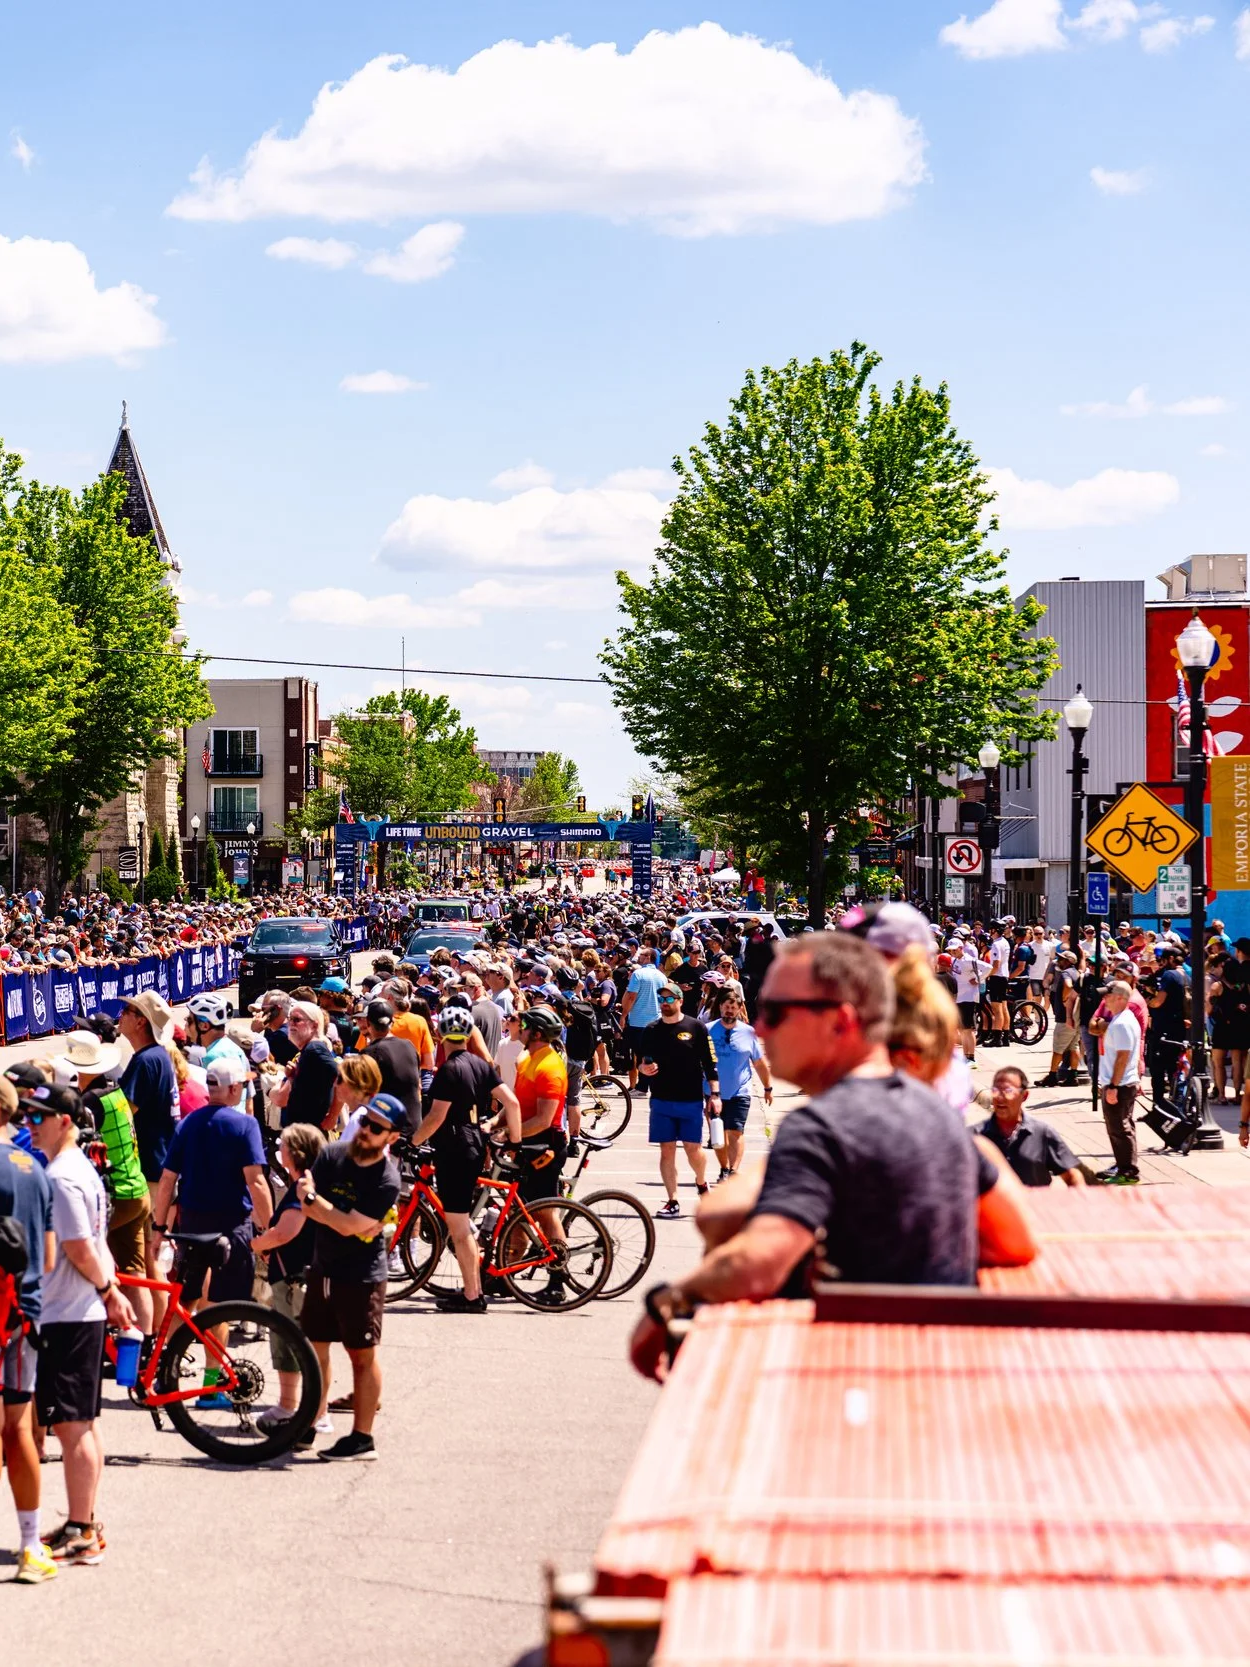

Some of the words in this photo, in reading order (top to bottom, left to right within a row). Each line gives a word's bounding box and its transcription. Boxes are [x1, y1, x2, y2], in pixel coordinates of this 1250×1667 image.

[1234, 763, 1248, 808] STATE
[385, 827, 401, 837] LIFE
[402, 827, 422, 837] TIME
[424, 826, 480, 839] UNBOUND
[482, 827, 535, 837] GRAVEL
[560, 828, 602, 836] SHIMANO
[224, 848, 259, 858] JOHNS
[1235, 812, 1248, 882] EMPORIA
[119, 870, 136, 879] ESU
[1160, 868, 1167, 881] 2
